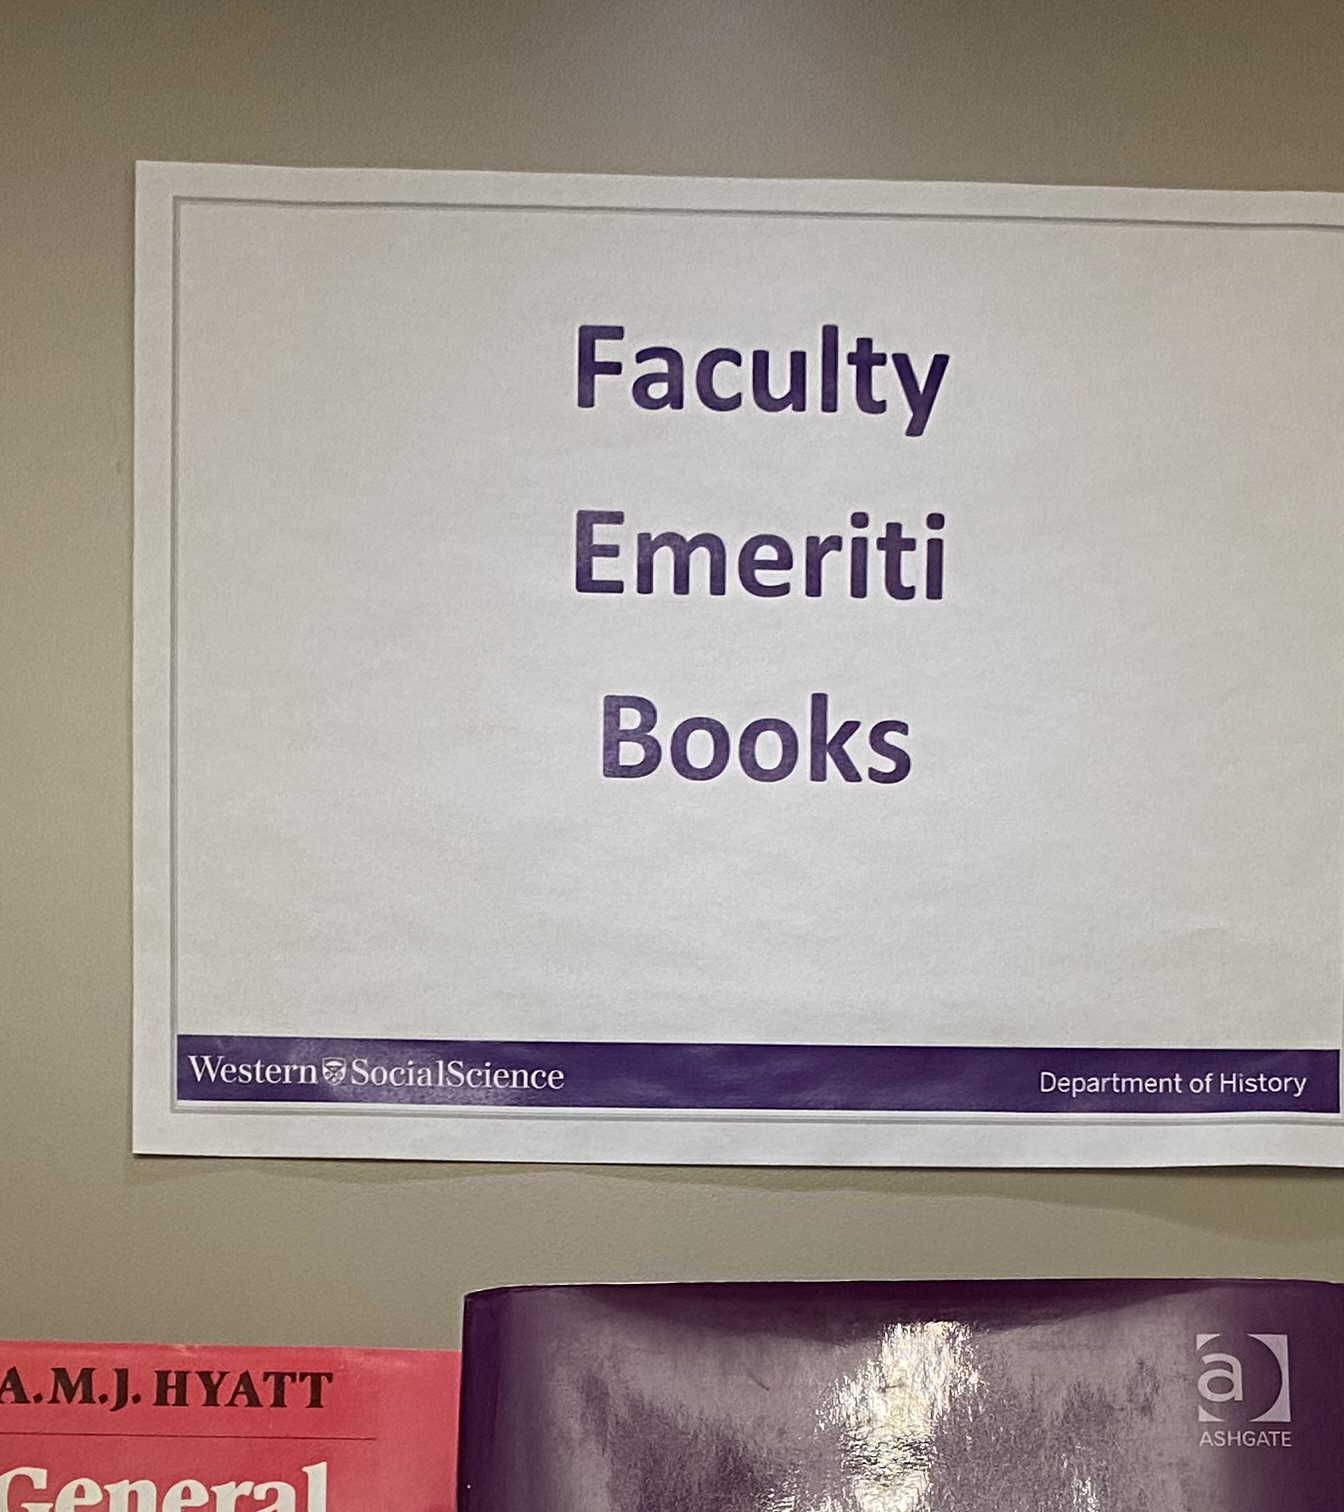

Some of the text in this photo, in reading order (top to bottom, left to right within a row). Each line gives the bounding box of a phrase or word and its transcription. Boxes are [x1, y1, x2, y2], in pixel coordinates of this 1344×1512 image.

[574, 322, 951, 437] Faculty
[573, 508, 946, 602] Emeriti
[600, 692, 913, 784] Books
[187, 1055, 565, 1090] Western SocialScience
[1040, 1071, 1307, 1098] Department of History
[152, 1370, 333, 1409] HYATT
[1199, 1430, 1292, 1447] ASHGATE
